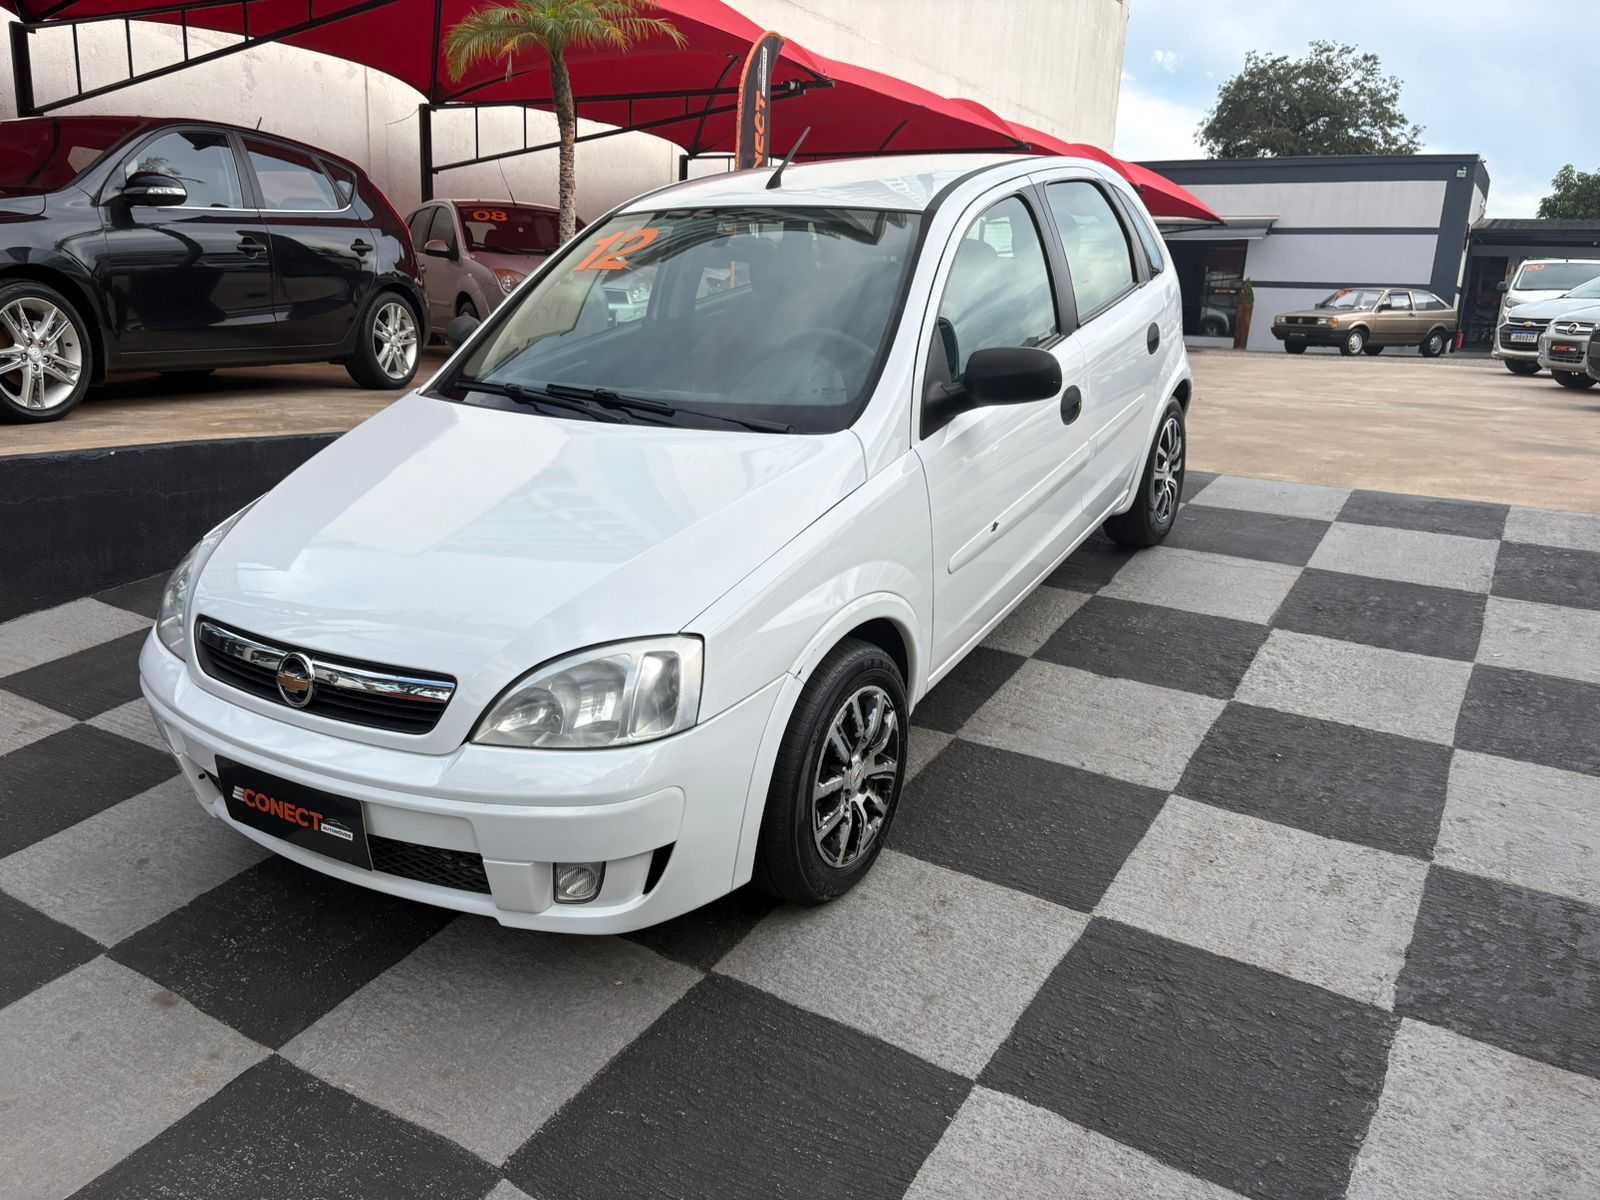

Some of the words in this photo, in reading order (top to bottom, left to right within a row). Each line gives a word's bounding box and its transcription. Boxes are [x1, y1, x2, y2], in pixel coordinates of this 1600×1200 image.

[472, 210, 508, 222] 08
[575, 227, 659, 272] 12
[242, 788, 323, 832] CONECT
